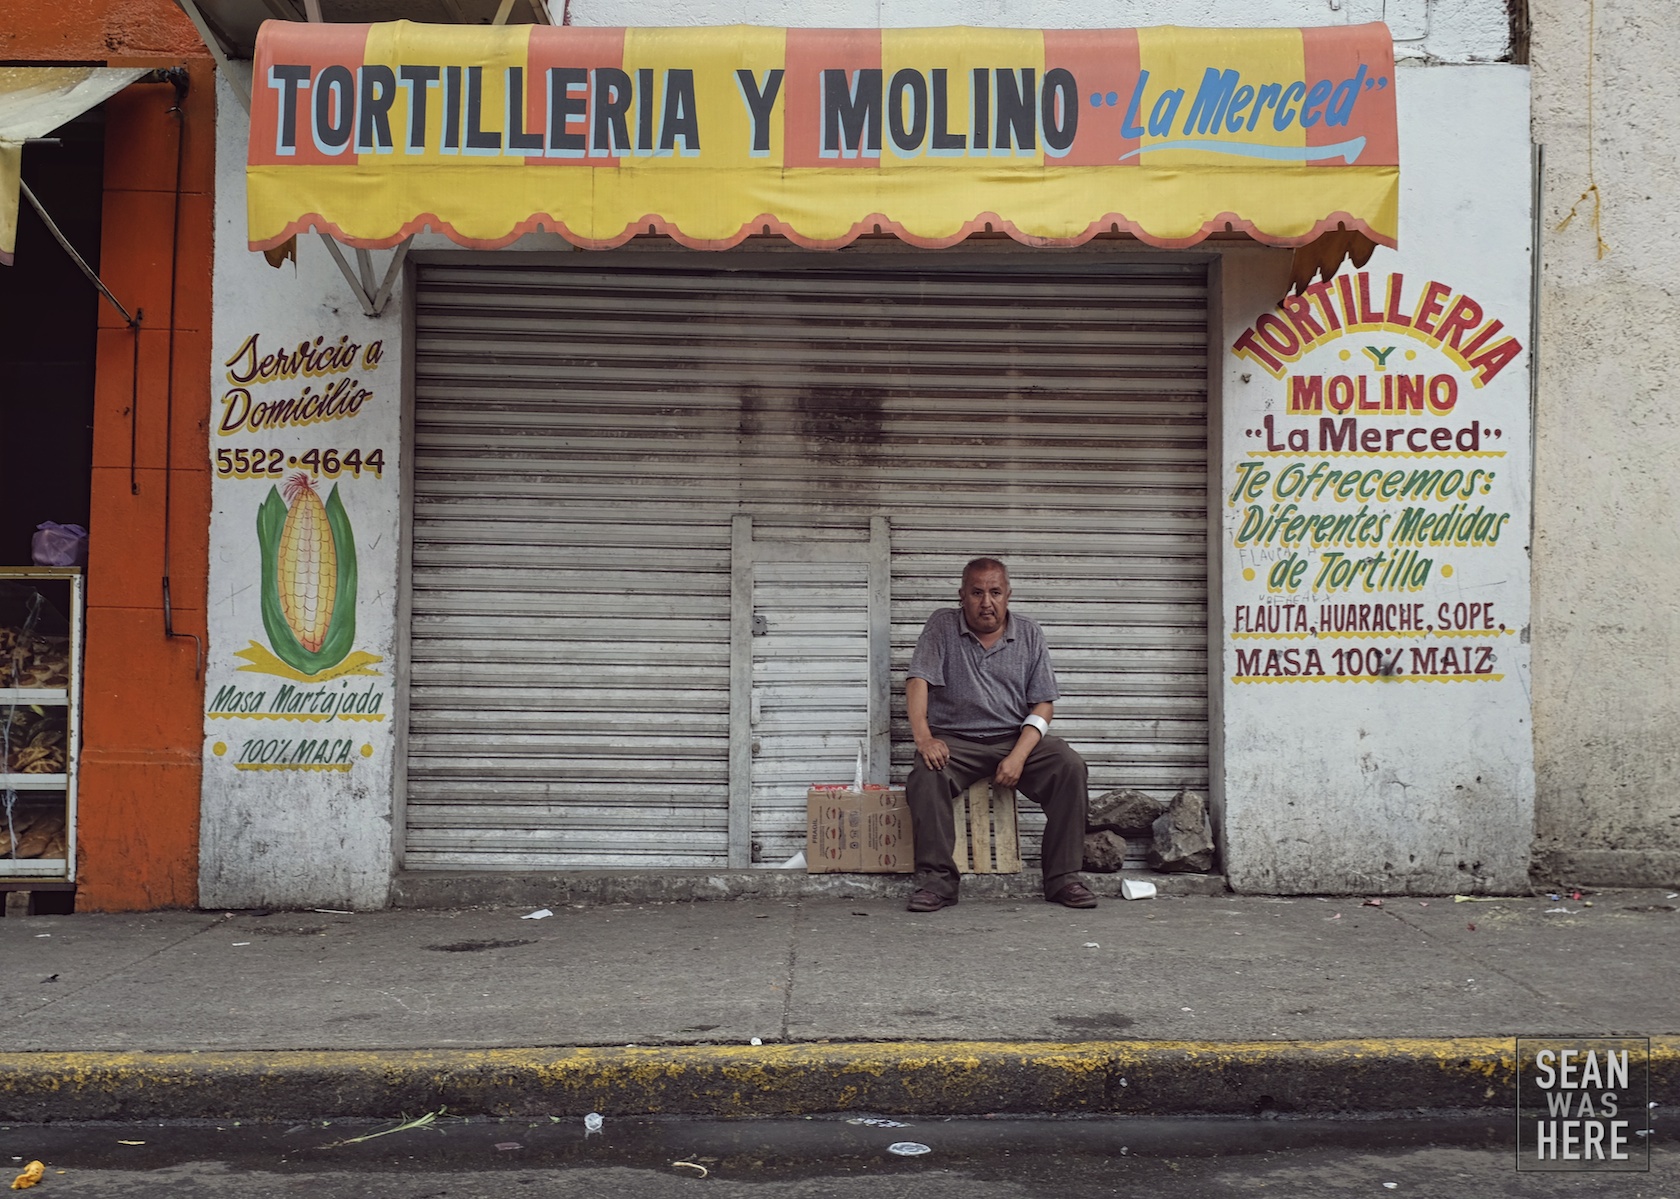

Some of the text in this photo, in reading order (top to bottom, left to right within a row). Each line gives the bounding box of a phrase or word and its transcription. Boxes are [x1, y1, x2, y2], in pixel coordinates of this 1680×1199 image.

[267, 64, 701, 157] TORTILLERIA
[733, 68, 785, 157] Y
[819, 67, 1079, 158] MOLINO
[1231, 272, 1523, 389] TORTILLERIA
[225, 333, 384, 387] Servicio a
[1361, 346, 1397, 371] Y
[217, 377, 373, 437] Domicilio
[1286, 373, 1459, 416] MOLINO
[1228, 461, 1496, 507] Te Ofrecemos:
[1234, 503, 1511, 549] Diferentes Medidas
[1267, 552, 1309, 593] de
[1312, 549, 1433, 593] Tortilla
[1235, 601, 1506, 635] FLAUTA, HUARACHE, SOPE,
[1235, 646, 1495, 677] MASA 100% MAIZ
[208, 680, 384, 723] Masa Martajada
[239, 739, 354, 764] 100% MASA
